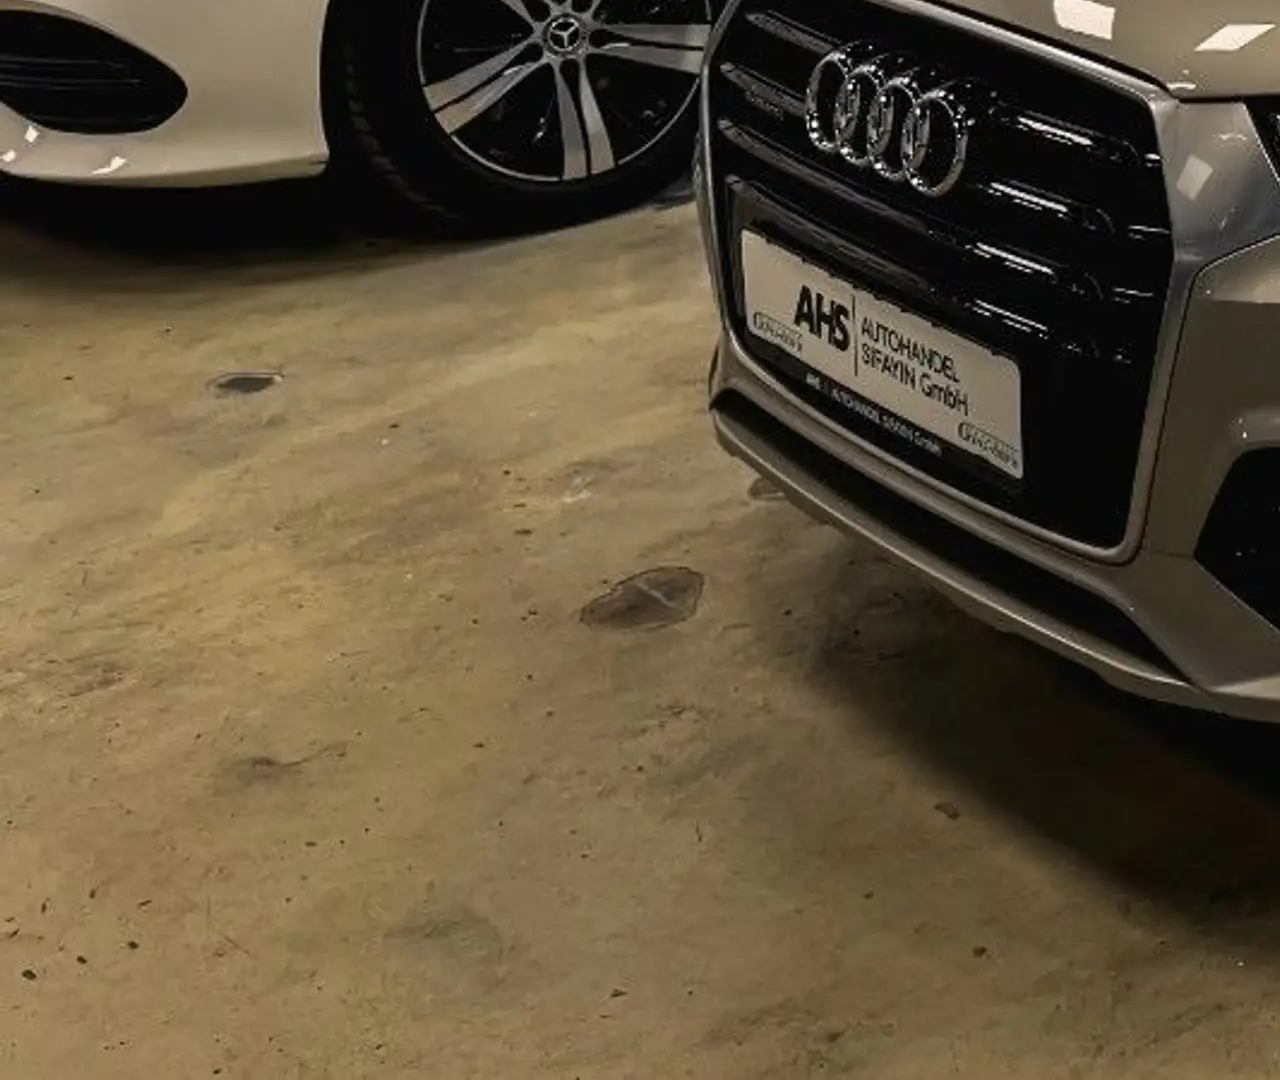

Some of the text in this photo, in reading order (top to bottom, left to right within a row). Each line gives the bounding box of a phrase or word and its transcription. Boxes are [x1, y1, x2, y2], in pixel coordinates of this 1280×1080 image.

[794, 284, 850, 352] AHS
[861, 316, 960, 383] AUTOHANDEL
[918, 372, 969, 417] GmbH
